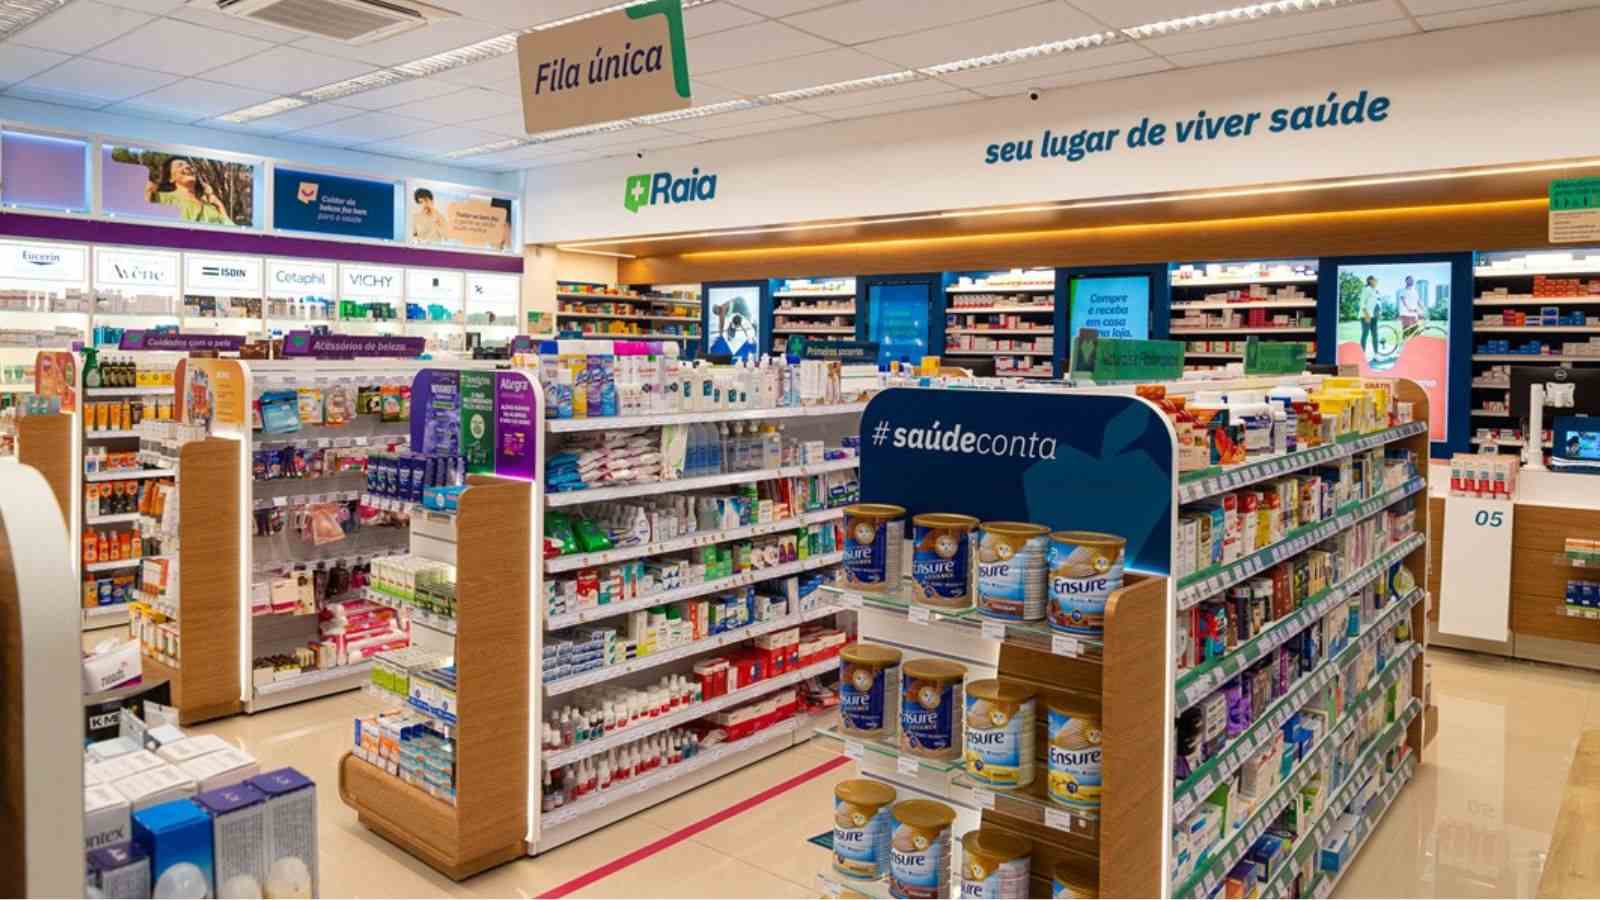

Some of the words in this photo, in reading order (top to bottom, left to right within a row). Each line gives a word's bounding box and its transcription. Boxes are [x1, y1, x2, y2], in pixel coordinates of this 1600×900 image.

[535, 57, 581, 95] Fila
[588, 43, 663, 84] única
[984, 138, 1034, 164] seu
[1040, 129, 1120, 163] lugar
[1127, 118, 1166, 148] de
[1175, 110, 1261, 143] viver
[1269, 90, 1392, 132] saúde
[650, 167, 718, 206] Raia
[22, 250, 60, 262] Eucerin
[220, 269, 247, 278] ISDIN
[275, 270, 326, 286] Cetaphil
[349, 273, 393, 288] VICHY
[1089, 293, 1129, 305] Compre
[1474, 510, 1504, 528] 05
[979, 564, 1009, 577] sure
[1054, 578, 1107, 594] Ensure
[841, 694, 870, 706] sure
[1050, 747, 1101, 766] Ensure
[837, 831, 864, 842] sure
